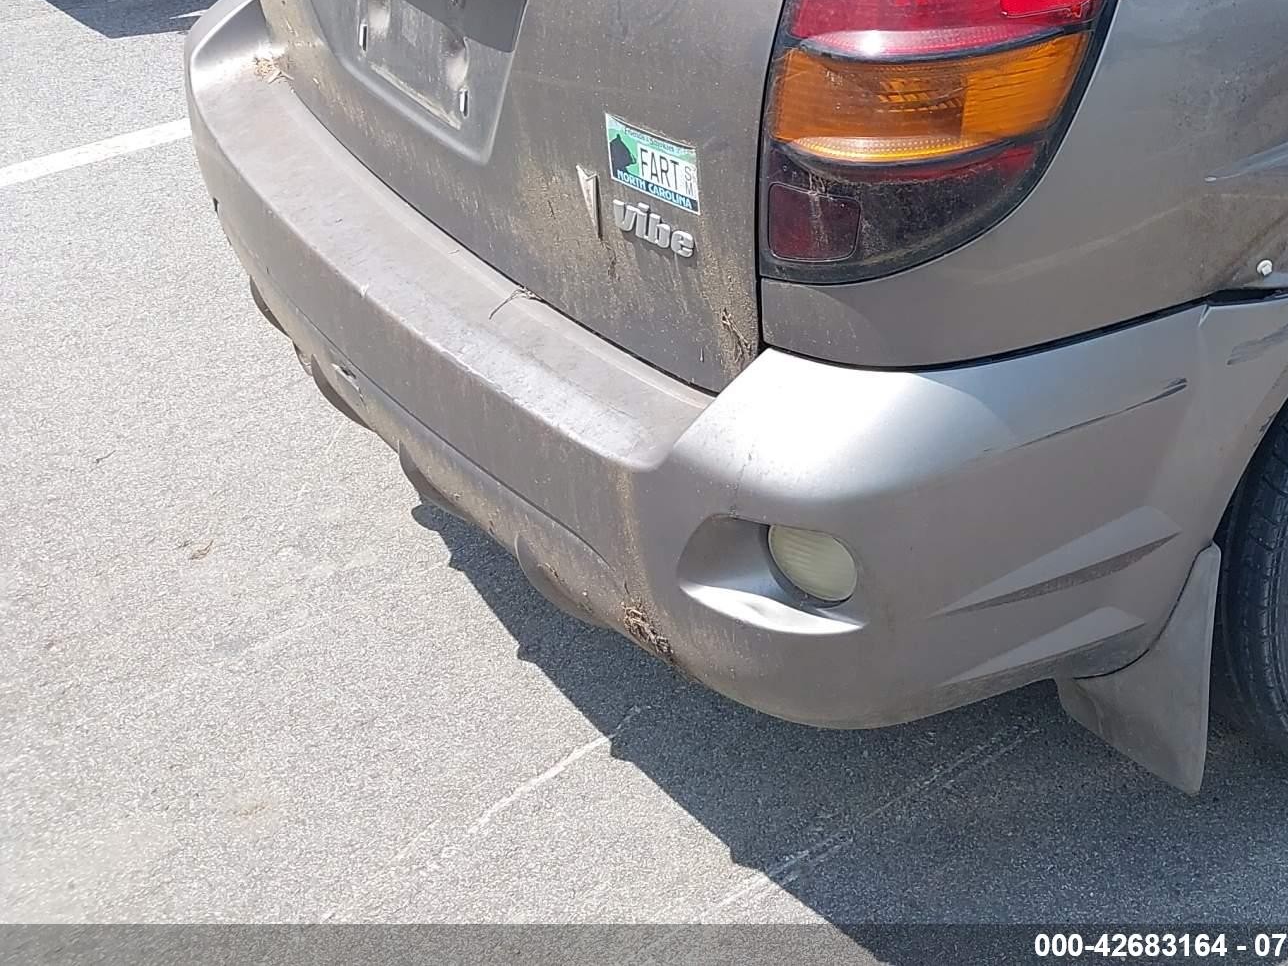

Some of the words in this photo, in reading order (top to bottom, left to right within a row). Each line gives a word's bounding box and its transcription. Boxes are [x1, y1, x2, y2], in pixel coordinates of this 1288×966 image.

[616, 168, 647, 190] NORTH
[648, 183, 693, 209] CAROLINA
[640, 147, 680, 190] FART
[612, 198, 694, 258] vibe
